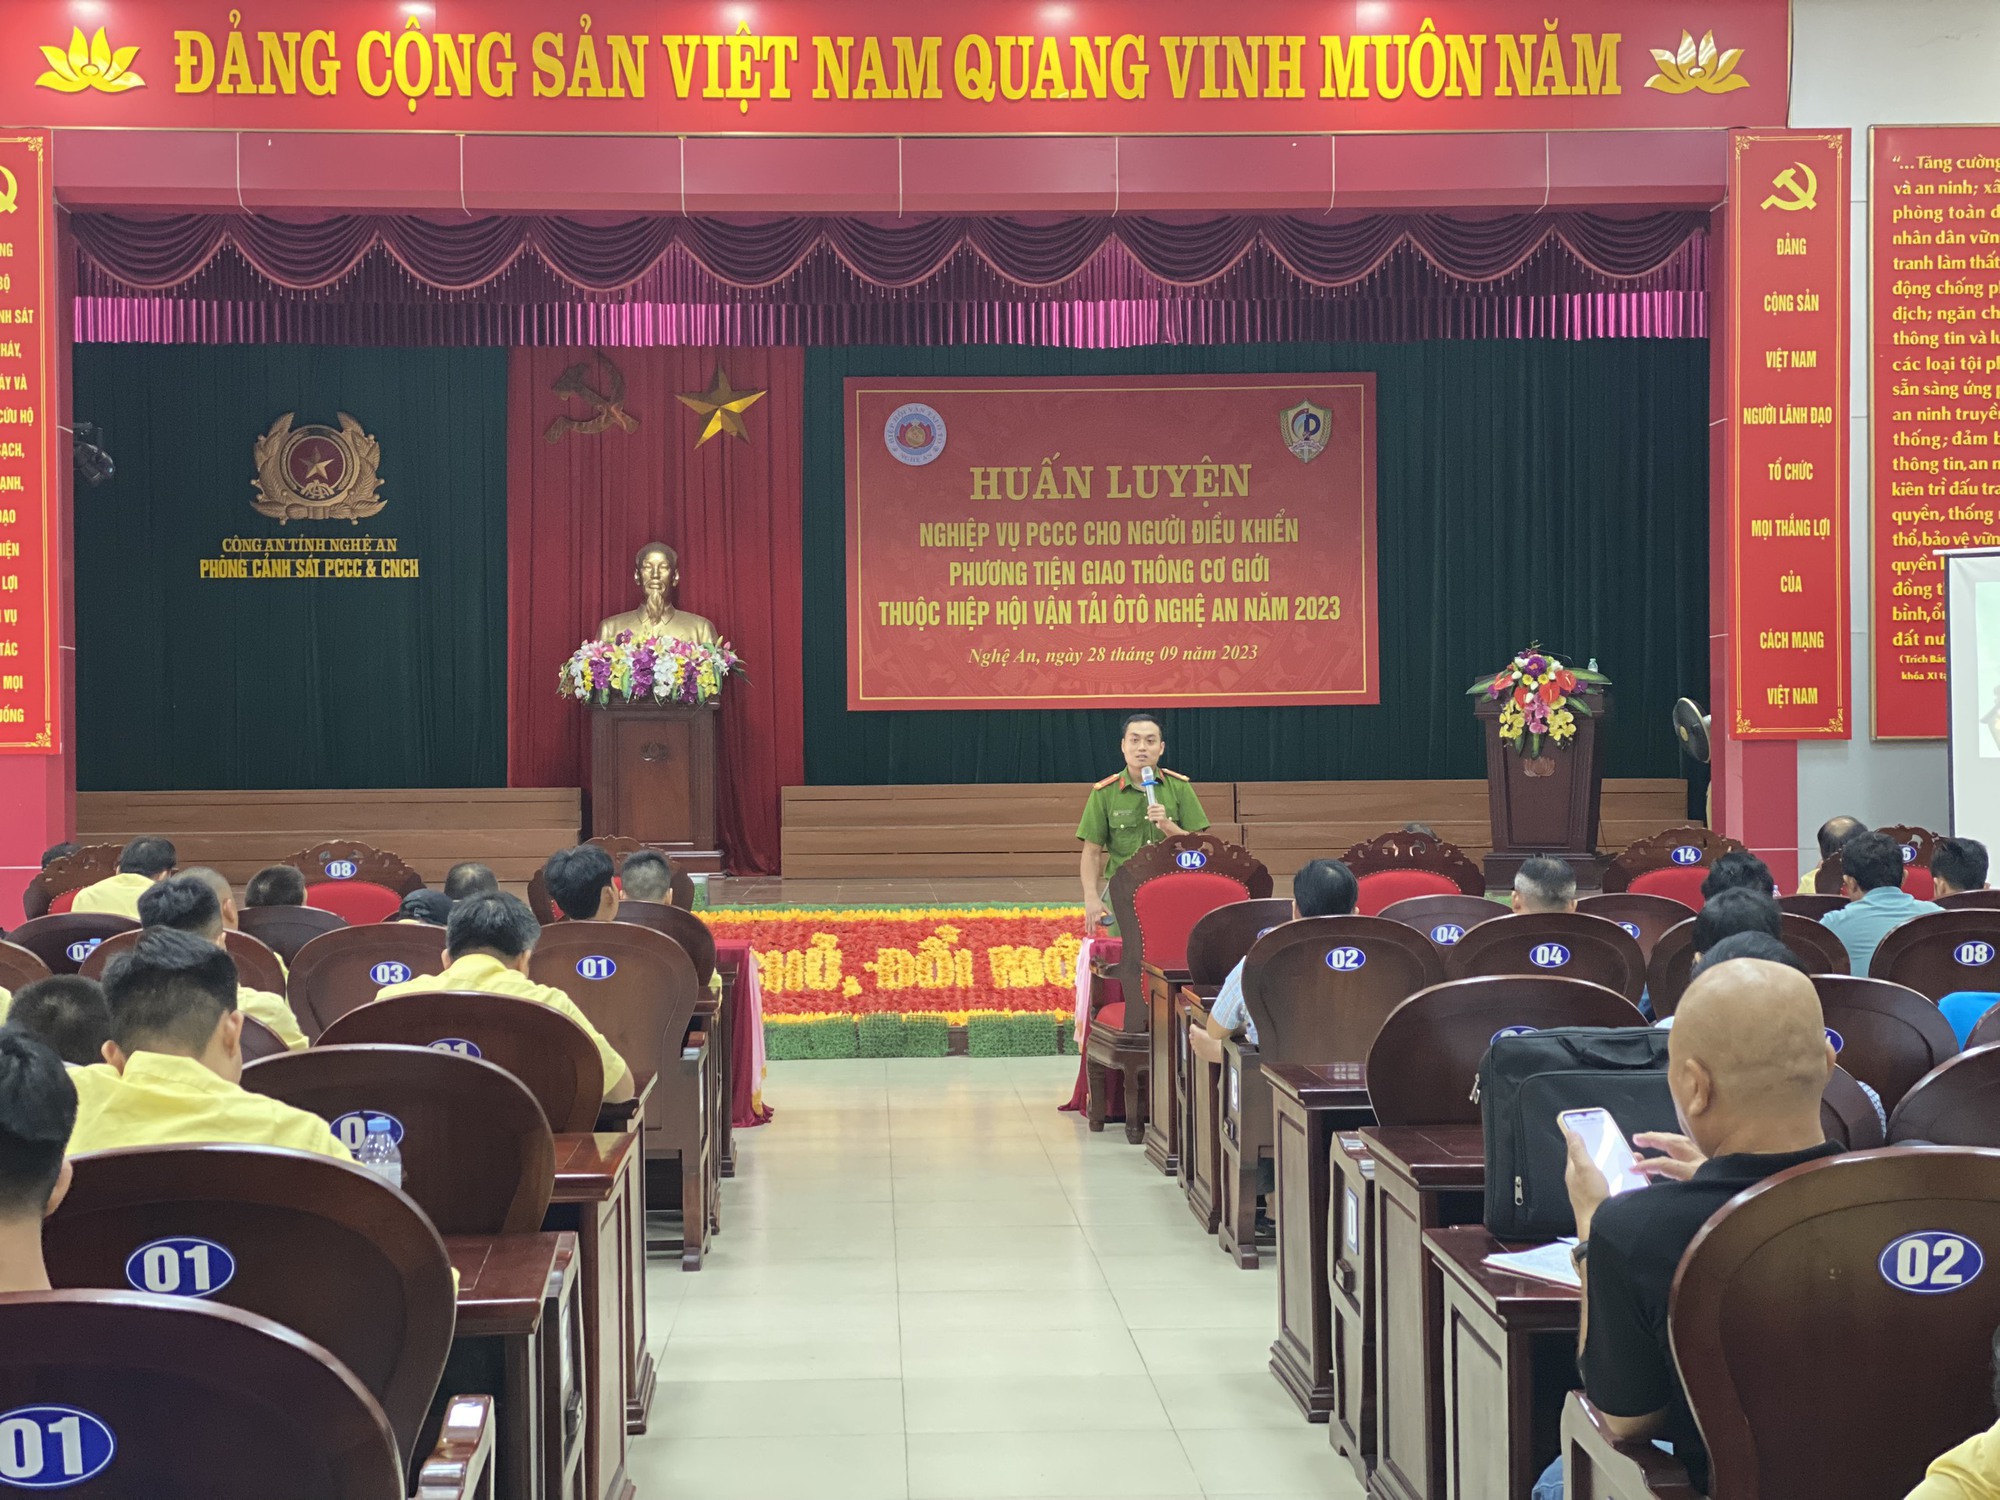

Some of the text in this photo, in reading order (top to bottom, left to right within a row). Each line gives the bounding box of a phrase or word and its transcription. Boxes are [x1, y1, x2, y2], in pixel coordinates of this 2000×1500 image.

[174, 9, 1622, 114] ĐẢNG CỘNG SẢN VIỆT NAM QUANG VINH MUÔN NĂM
[1893, 180, 1911, 195] và
[1915, 184, 1934, 194] an
[1938, 179, 1978, 196] ninh;
[1893, 205, 1944, 224] phòng
[1948, 203, 1985, 219] toàn
[1776, 233, 1807, 255] ĐẢNG
[1892, 230, 1932, 245] nhân
[1935, 229, 1965, 244] dân
[1893, 255, 1933, 270] tranh
[1938, 254, 1966, 269] làm
[1892, 280, 1931, 299] động
[1936, 276, 1984, 298] chống
[1764, 289, 1819, 315] CỘNG SẢN
[15, 307, 34, 324] SÁT
[1892, 306, 1932, 324] địch;
[1937, 306, 1976, 324] ngăn
[1893, 330, 1939, 349] thông
[1944, 331, 1965, 345] tin
[1969, 330, 1987, 344] và
[1766, 347, 1817, 372] VIỆT NAM
[1892, 356, 1921, 371] các
[1926, 356, 1955, 374] loại
[1960, 355, 1981, 374] tội
[14, 373, 27, 390] VÀ
[1892, 378, 1920, 396] sẵn
[1923, 380, 1959, 399] sàng
[1963, 379, 1992, 399] ứng
[20, 407, 34, 426] HỘ
[1743, 403, 1832, 427] NGƯỜI LÃNH ĐẠO
[1892, 402, 2000, 425] an ninh truyề
[1952, 430, 1988, 445] đảm
[1768, 457, 1813, 480] TỔ CHỨC
[1892, 456, 1939, 475] thông
[970, 451, 1252, 508] HUẤN LUYỆN
[1892, 481, 1924, 496] kiên
[1949, 478, 1978, 495] đấu
[1892, 503, 1994, 526] quyền, thống
[919, 508, 1298, 552] NGHIỆP VỤ PCCC CHO NGƯỜI ĐIỀU KHIỂN
[1751, 513, 1831, 540] MỌI THẮNG LỢI
[222, 534, 262, 552] CÔNG
[265, 538, 286, 552] AN
[375, 538, 398, 552] AN
[1953, 532, 1970, 549] vệ
[252, 553, 291, 578] CẢNH
[296, 554, 320, 578] SÁT
[325, 559, 361, 578] PCCC
[366, 559, 377, 578] &
[381, 558, 419, 578] CNCH
[950, 552, 1269, 590] PHƯƠNG TIỆN GIAO THÔNG CƠ GIỚI
[1892, 554, 1937, 575] quyền
[2, 574, 18, 593] LỢI
[1780, 570, 1802, 592] CỦA
[1892, 578, 1933, 600] đồng
[4, 608, 17, 626] VỤ
[878, 591, 1340, 631] THUỘC HIỆP HỘI VẬN TẢI ÔTÔ NGHỆ AN NĂM 2023
[1760, 629, 1824, 652] CÁCH MẠNG
[1892, 629, 1920, 646] đất
[968, 644, 1258, 667] Nghệ An, ngày 28 tháng 09 năm 2023
[3, 675, 23, 692] MỌI
[1767, 684, 1818, 708] VIỆT NAM
[1181, 852, 1201, 868] 04
[1678, 847, 1696, 863] 14
[331, 862, 352, 878] 08
[1437, 927, 1461, 943] 04
[1332, 950, 1360, 969] 02
[1536, 946, 1563, 965] 04
[1961, 944, 1987, 963] 08
[377, 963, 404, 984] 03
[583, 957, 609, 977] 01
[143, 1245, 210, 1295] 01
[1897, 1238, 1964, 1286] 02
[0, 1416, 83, 1479] 01
